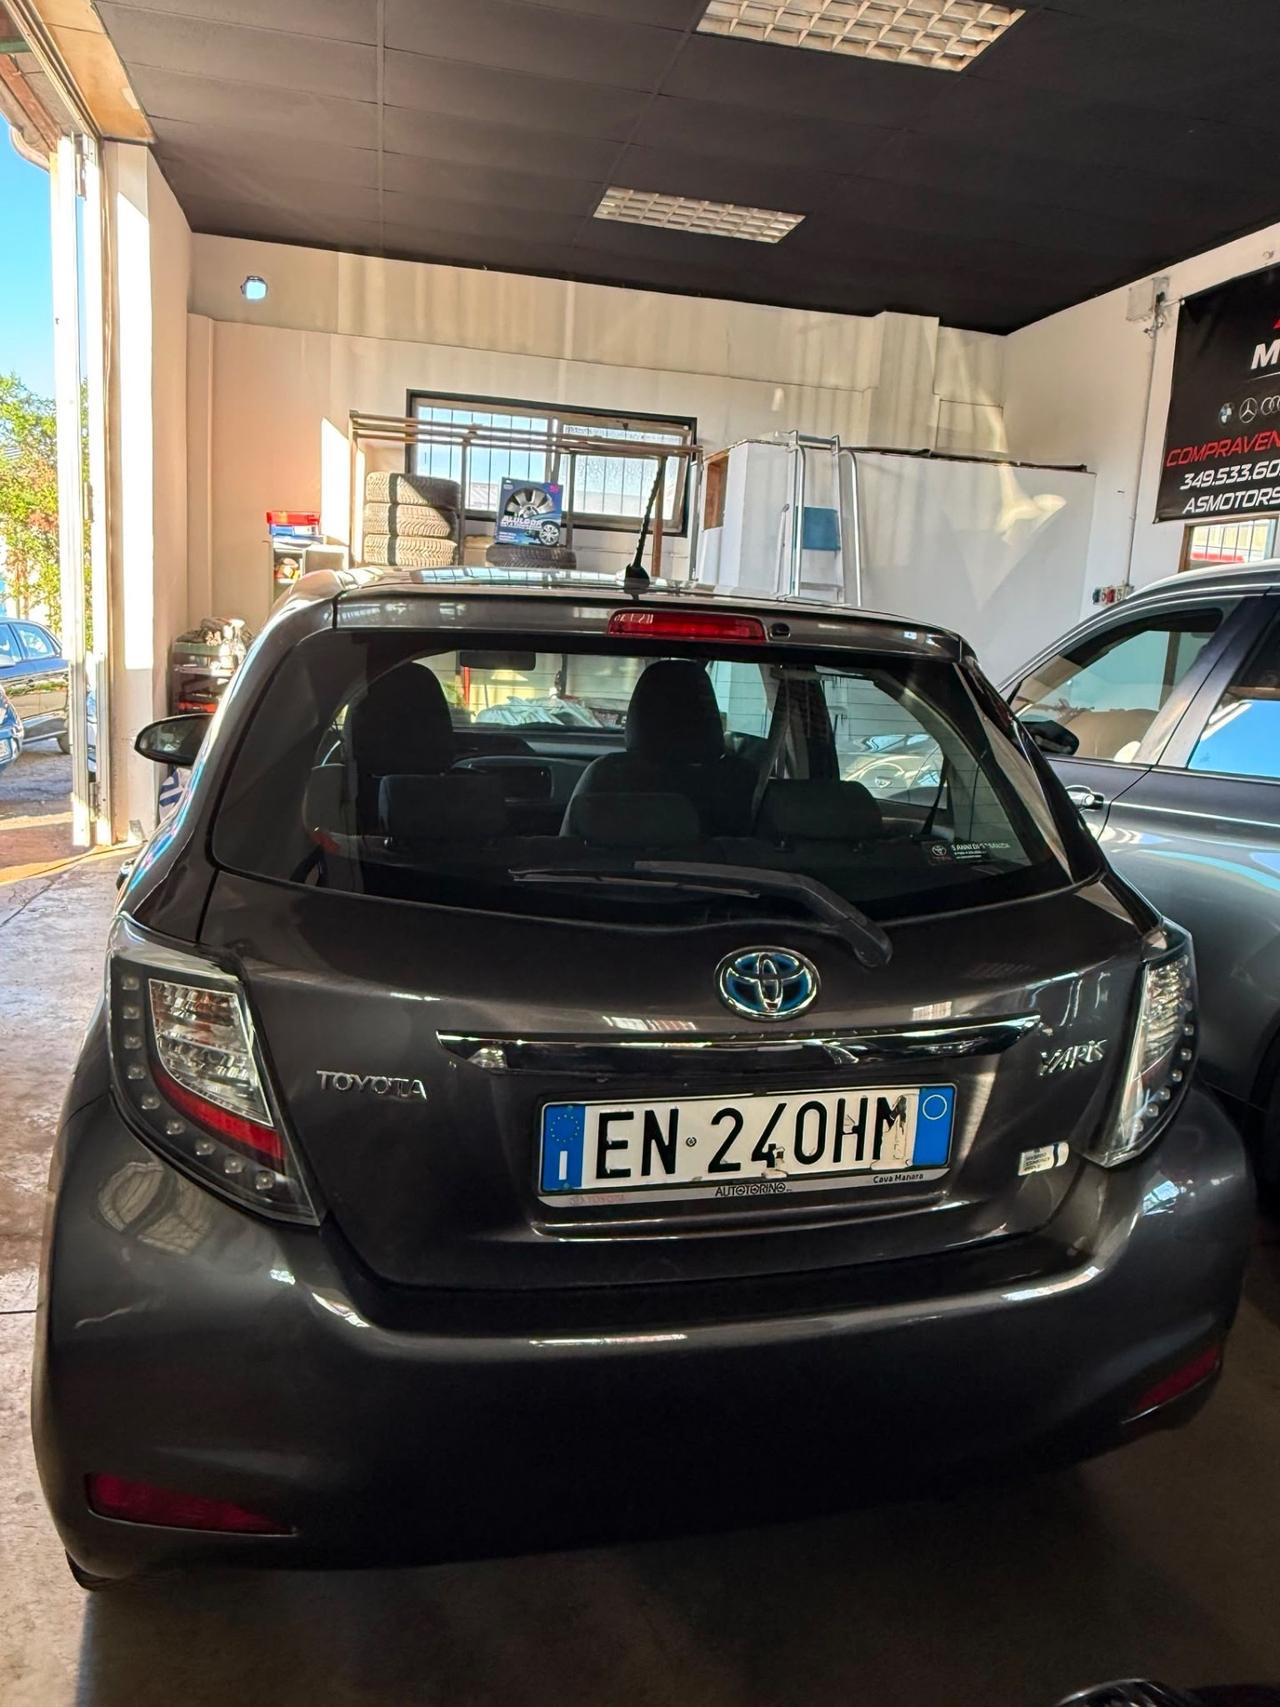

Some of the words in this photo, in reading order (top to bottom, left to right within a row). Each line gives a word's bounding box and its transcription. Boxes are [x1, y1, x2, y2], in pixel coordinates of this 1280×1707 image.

[1166, 430, 1280, 467] COMPRAVEN
[1180, 459, 1280, 490] 349.533.60
[1182, 487, 1280, 514] ASMOTORS
[316, 1070, 428, 1100] TOYOTA
[596, 1109, 679, 1179] EN
[715, 1183, 786, 1197] AUTOTORINO
[873, 1175, 893, 1184] Cava
[895, 1173, 924, 1182] Manara
